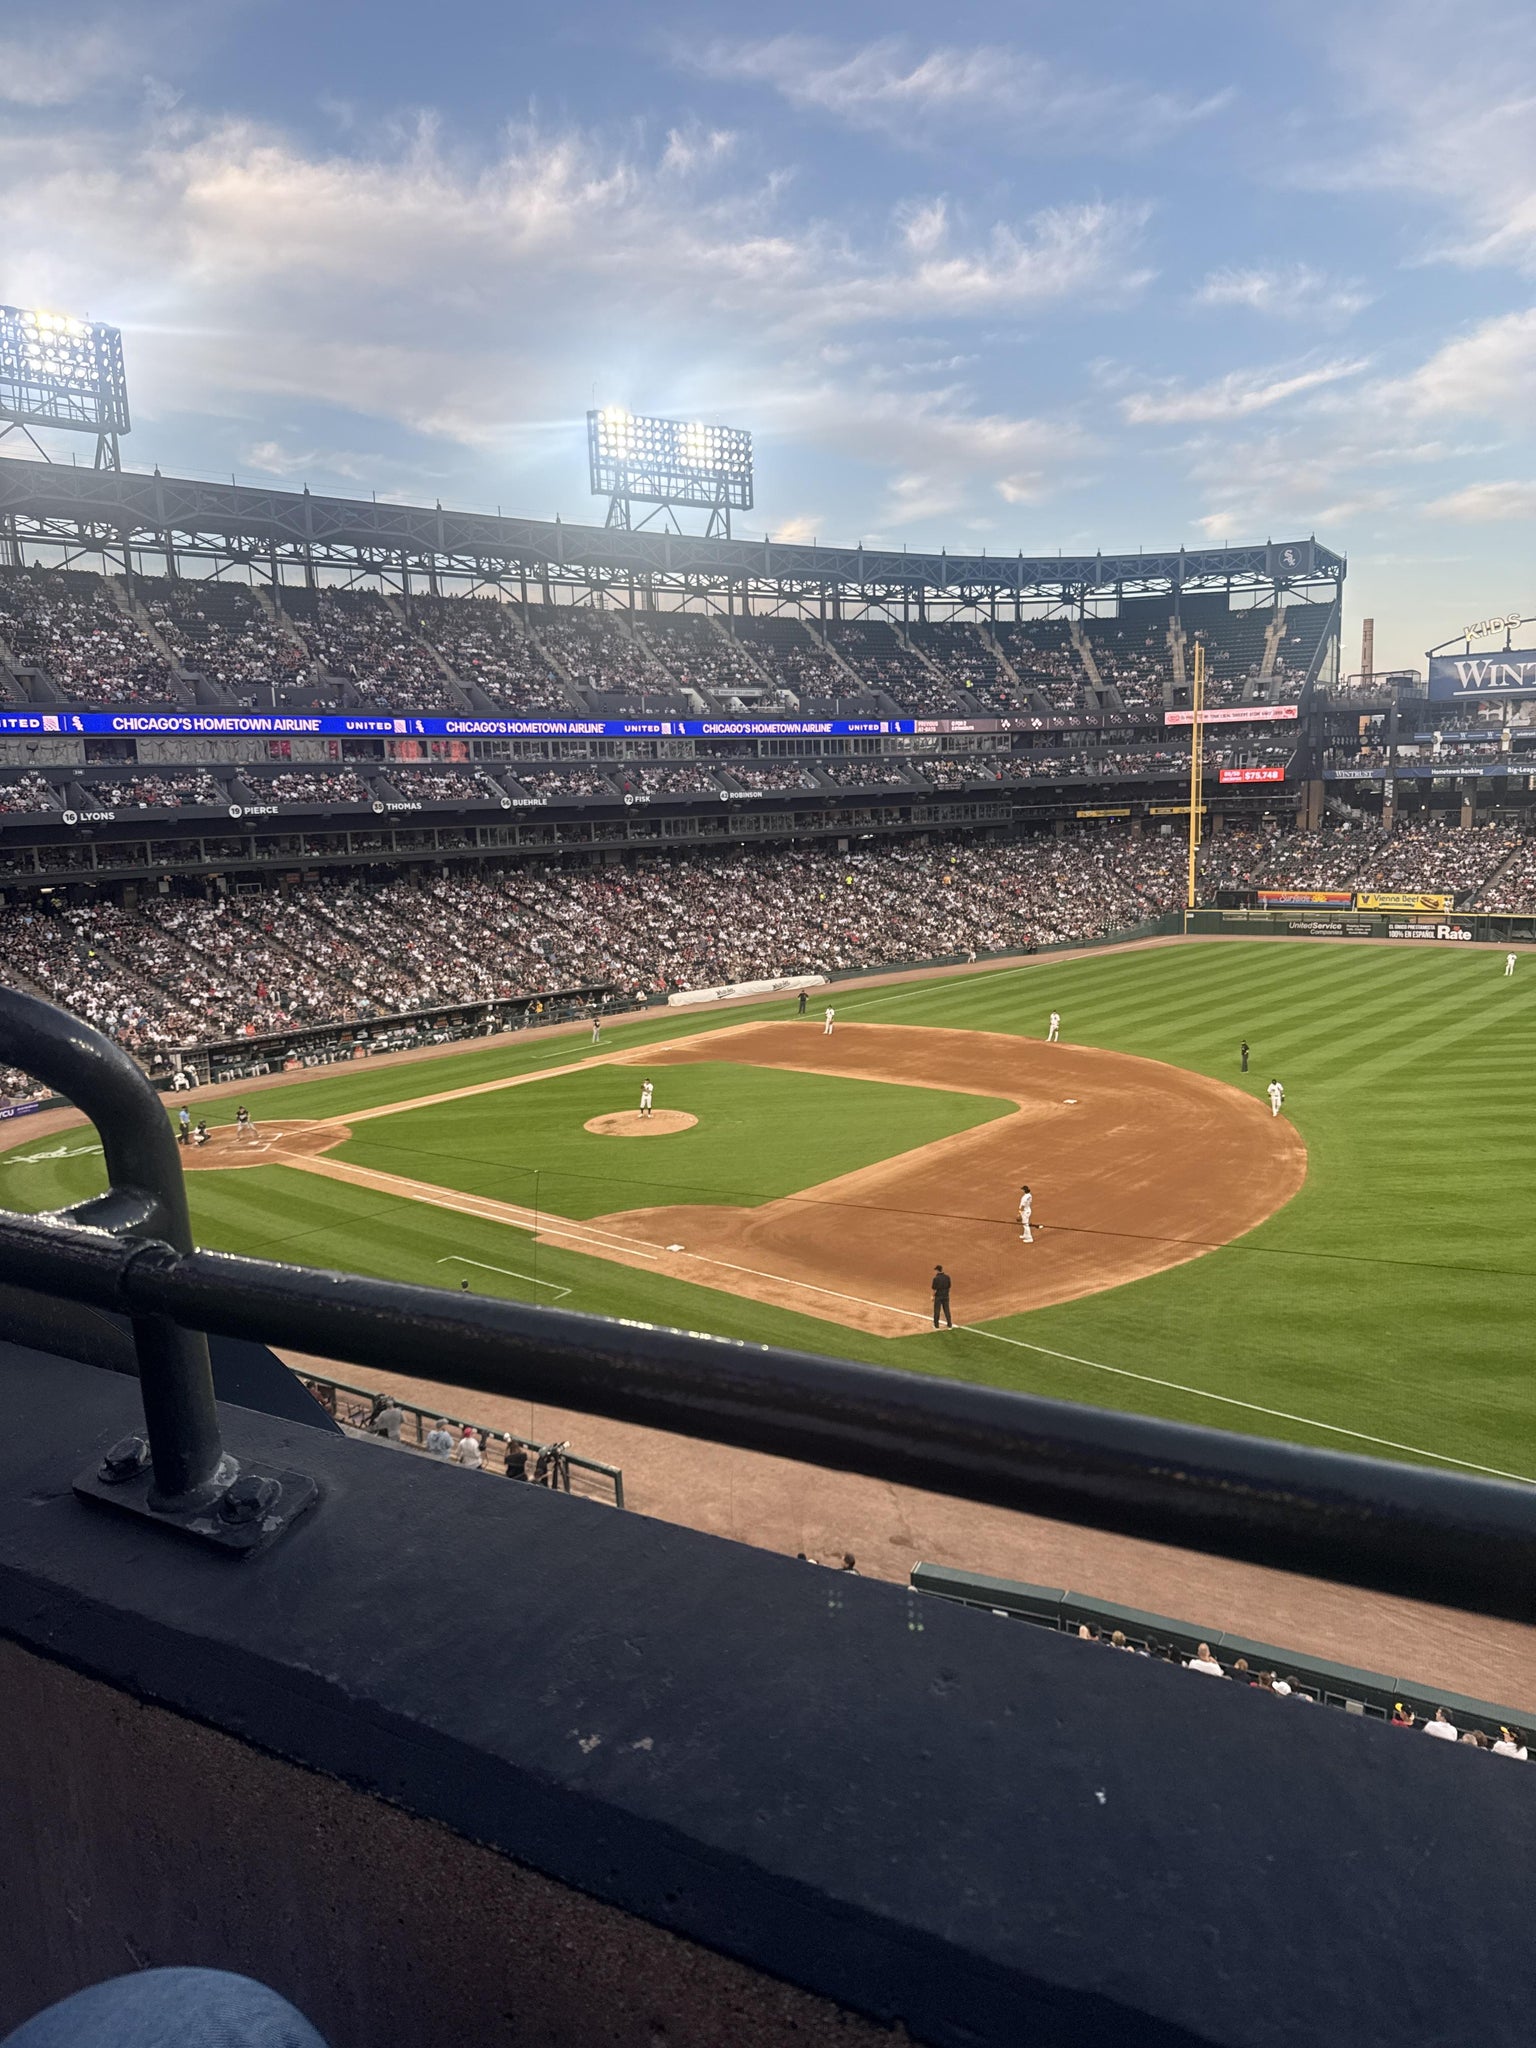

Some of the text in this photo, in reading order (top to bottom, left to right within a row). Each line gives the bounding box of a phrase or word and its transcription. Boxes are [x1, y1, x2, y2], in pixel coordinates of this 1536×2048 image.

[1463, 613, 1521, 642] KIDS
[0, 719, 40, 729] ITED
[112, 717, 192, 731] CHICAGO'S
[193, 718, 271, 731] HOMETOWN
[346, 722, 392, 731] UNITED
[446, 721, 507, 733] CHICAGO'S
[507, 722, 567, 733] HOMETOWN
[702, 723, 751, 734] CHICAGO'S
[751, 723, 801, 734] HOMETOWN
[1335, 770, 1374, 778] WINTRUST
[1461, 767, 1484, 775] Banking
[634, 795, 651, 803] FISK
[730, 791, 763, 799] ROBINSON
[386, 802, 422, 811] THOMAS
[512, 798, 547, 806] BUEHRLE
[231, 806, 279, 815] 19 PIERCE
[65, 812, 115, 821] 16 LYONS
[1402, 895, 1419, 903] Beef
[1388, 930, 1436, 939] 100% EN ESPAÑOL
[1437, 925, 1472, 941] Rate
